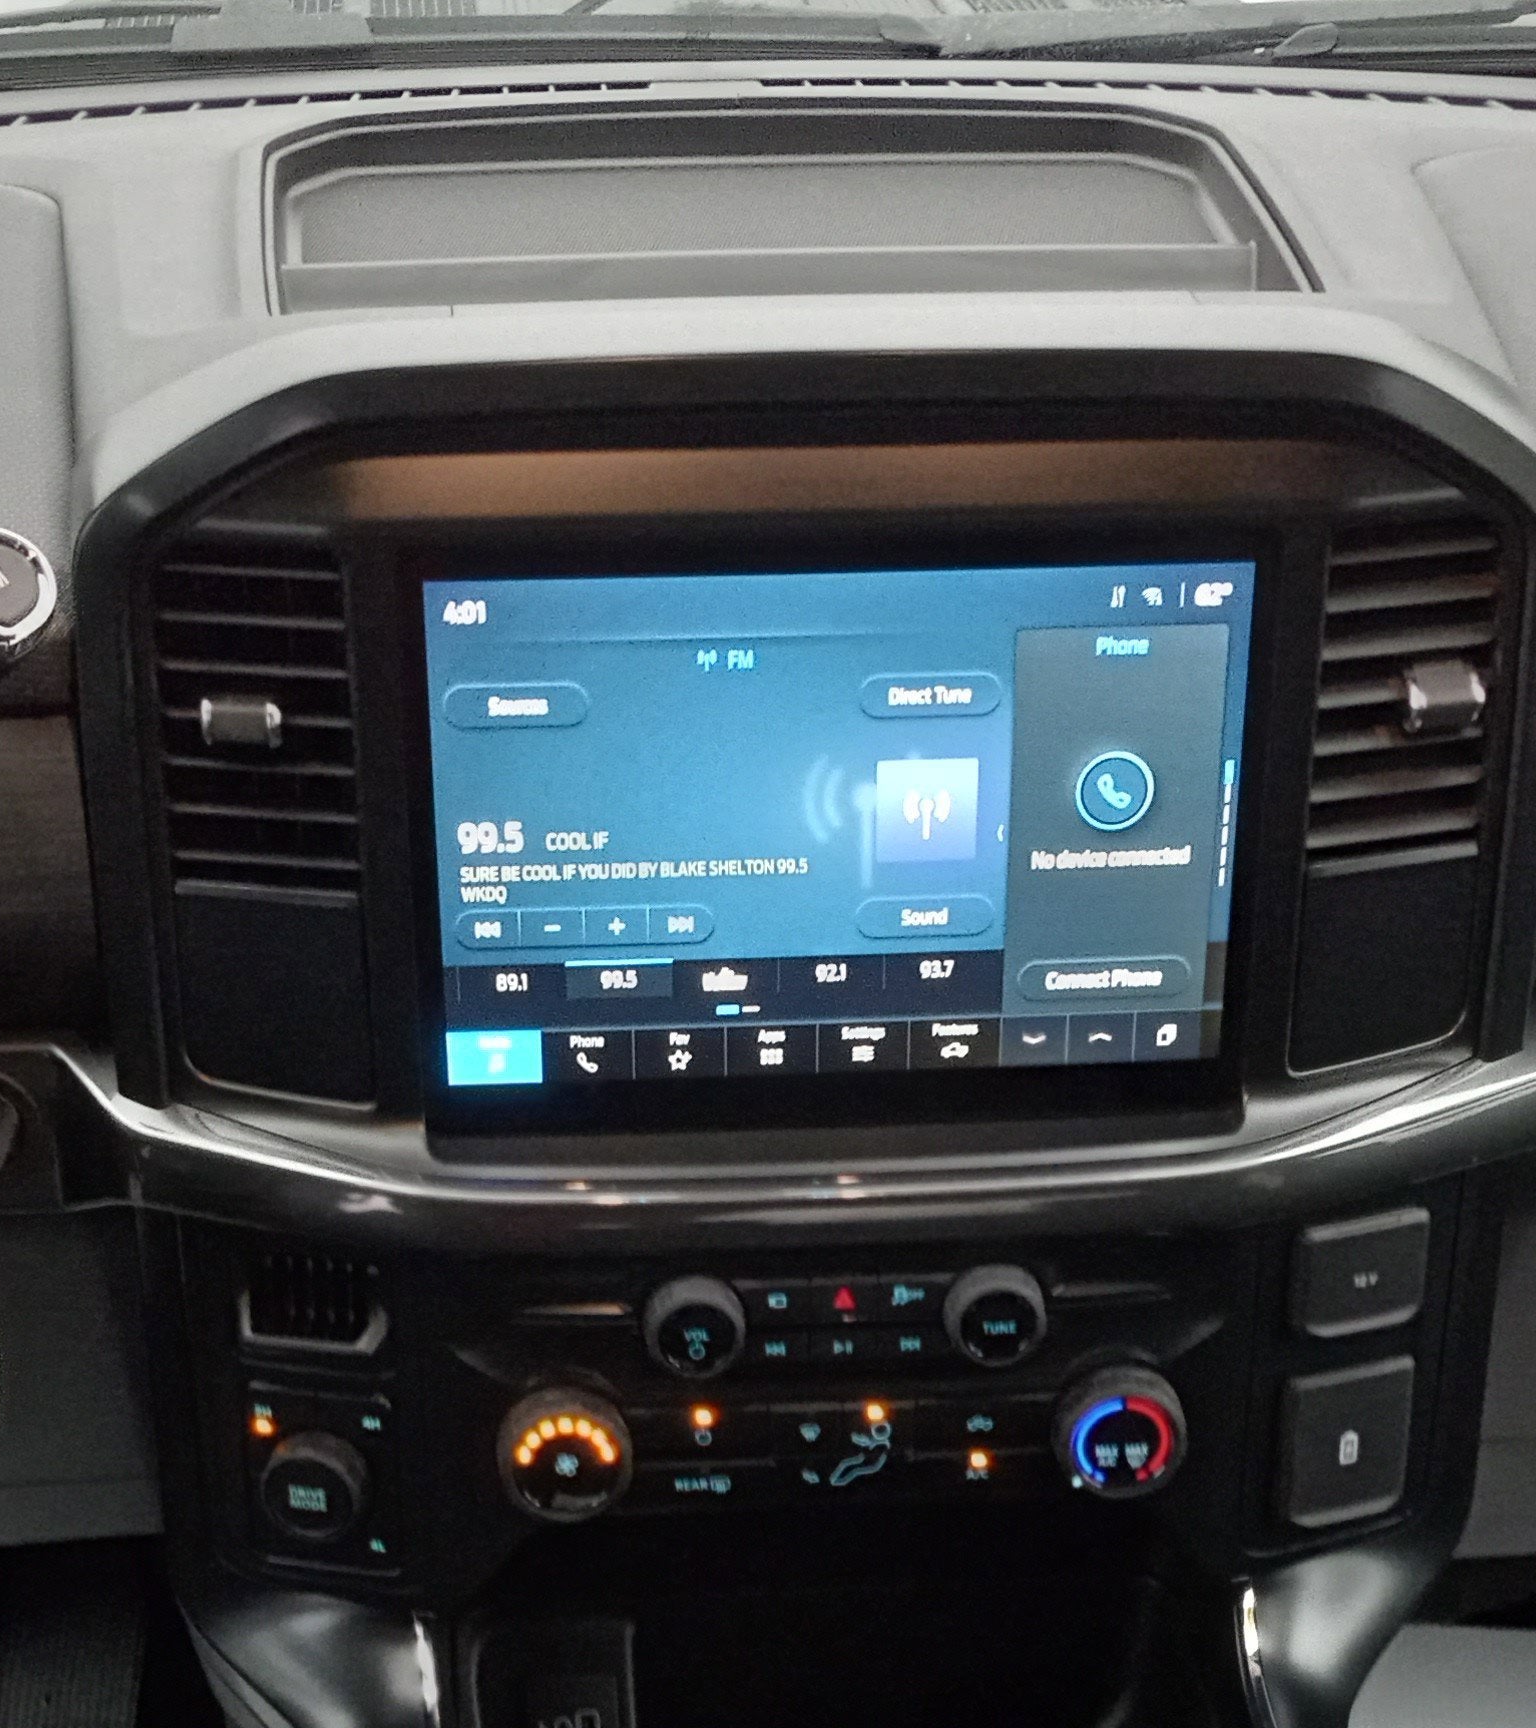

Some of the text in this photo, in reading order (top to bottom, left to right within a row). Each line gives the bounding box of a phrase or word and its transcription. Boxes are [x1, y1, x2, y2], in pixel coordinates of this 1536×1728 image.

[442, 600, 487, 625] 4:01
[1095, 636, 1150, 656] Phone
[726, 649, 755, 671] FM
[887, 685, 973, 706] Direct Tune
[456, 820, 610, 855] 99.5 COOL IF
[1030, 845, 1193, 870] No device connected
[460, 857, 809, 883] SURE BE COOL IF YOU DID BY BLAKE SHELTON 99.5
[460, 886, 508, 904] WKDQ
[901, 907, 949, 926] Sound
[599, 969, 638, 989] 99.5
[815, 963, 848, 983] 92.1
[919, 960, 956, 979] 93.7
[1045, 968, 1164, 991] Connect Phone
[495, 972, 529, 992] 89.1
[569, 1035, 605, 1049] Phone
[982, 1319, 1018, 1336] TUNE
